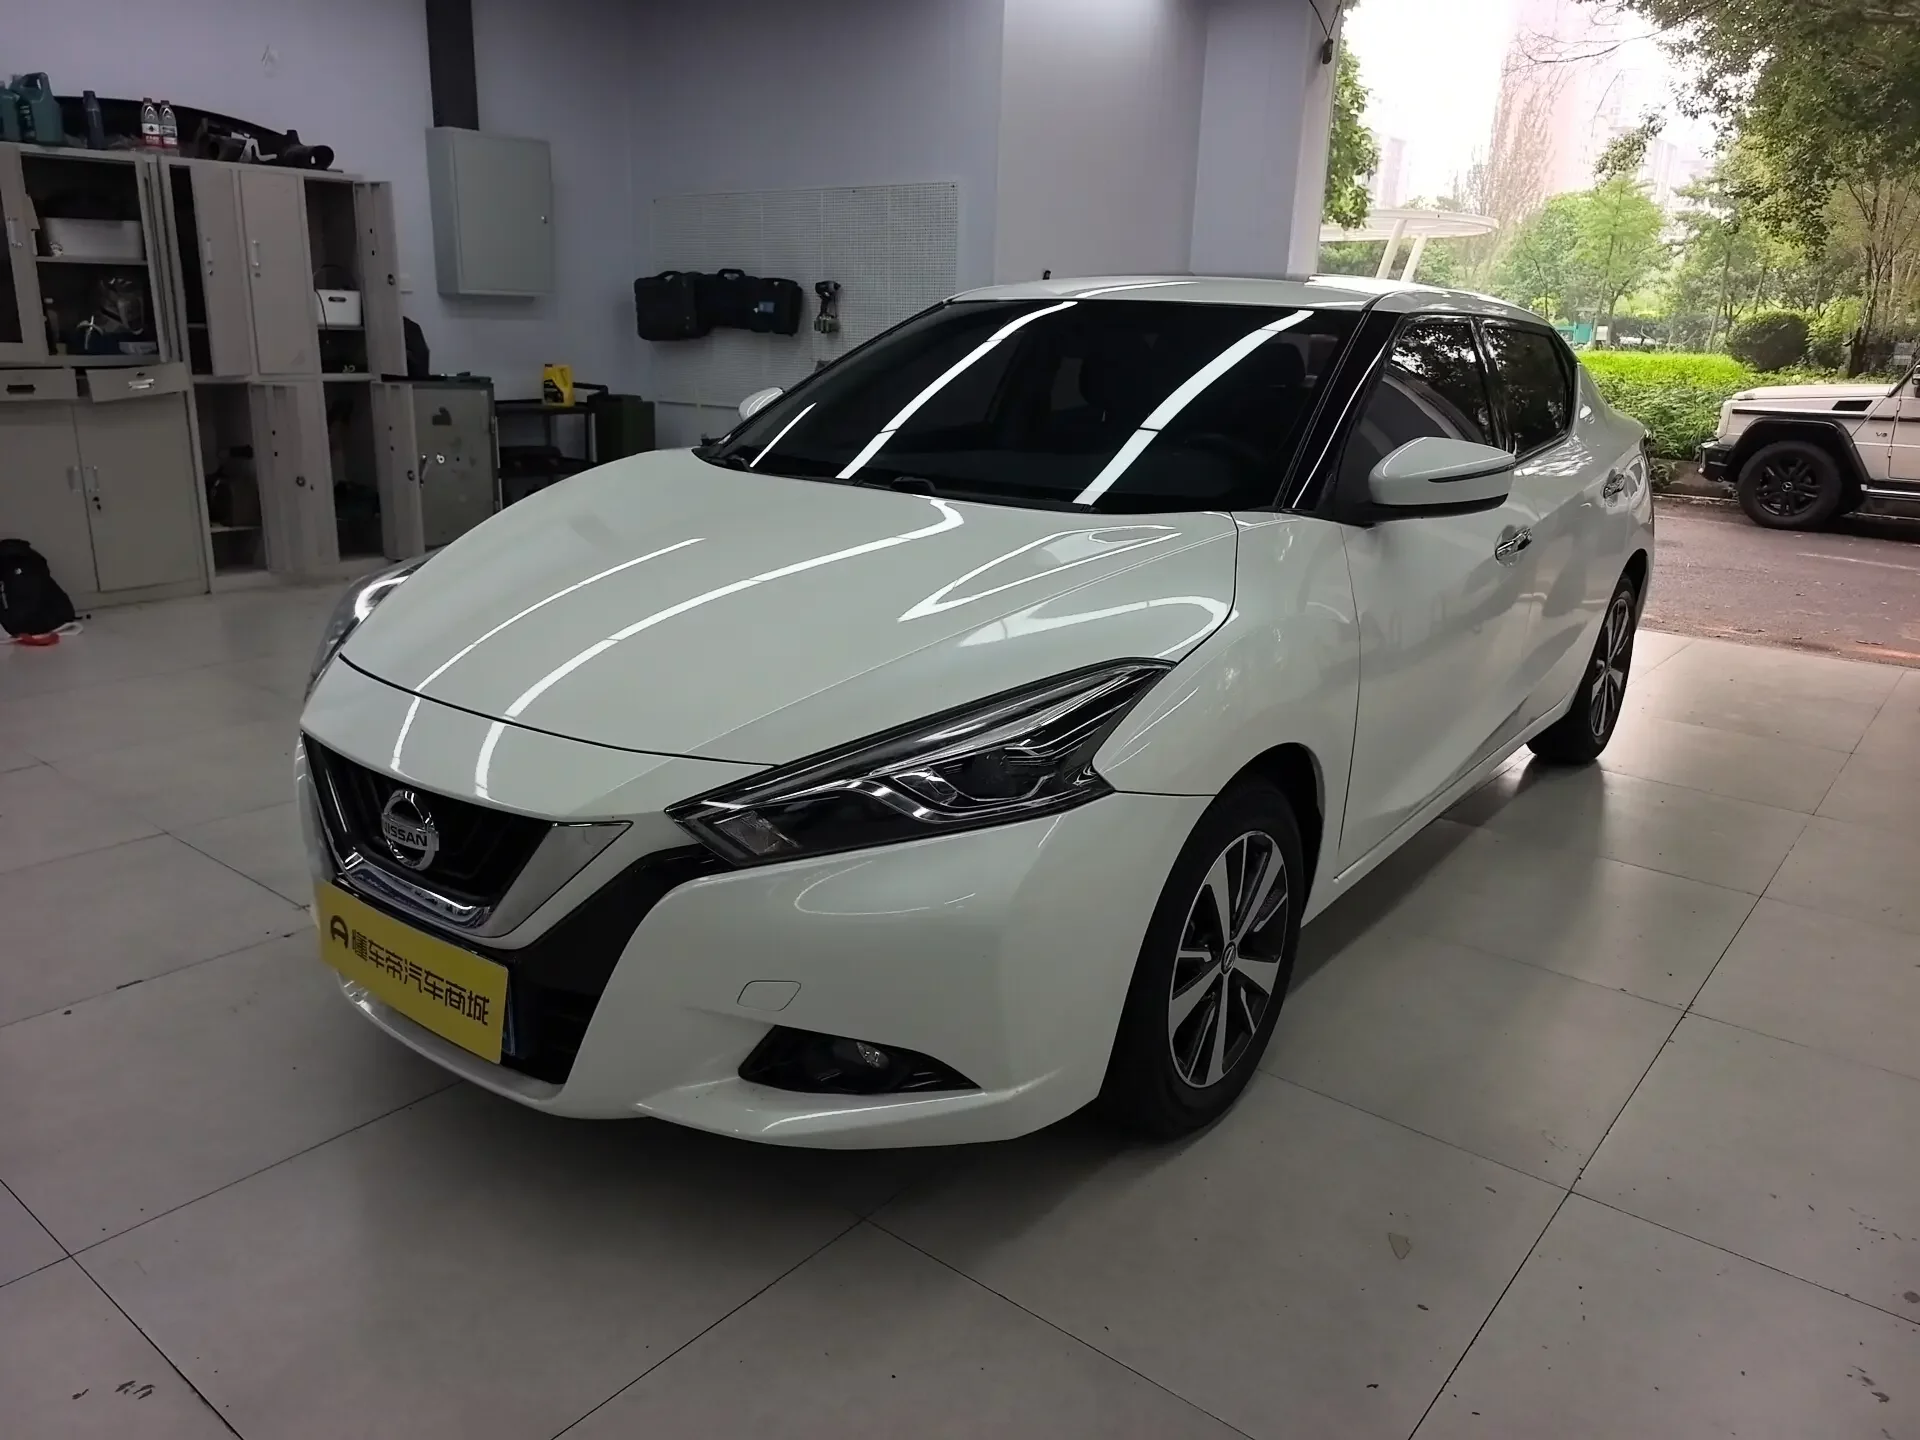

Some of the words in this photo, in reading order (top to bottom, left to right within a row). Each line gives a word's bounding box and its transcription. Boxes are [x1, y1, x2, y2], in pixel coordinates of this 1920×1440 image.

[352, 929, 490, 1026] 懂车帝汽车商城
